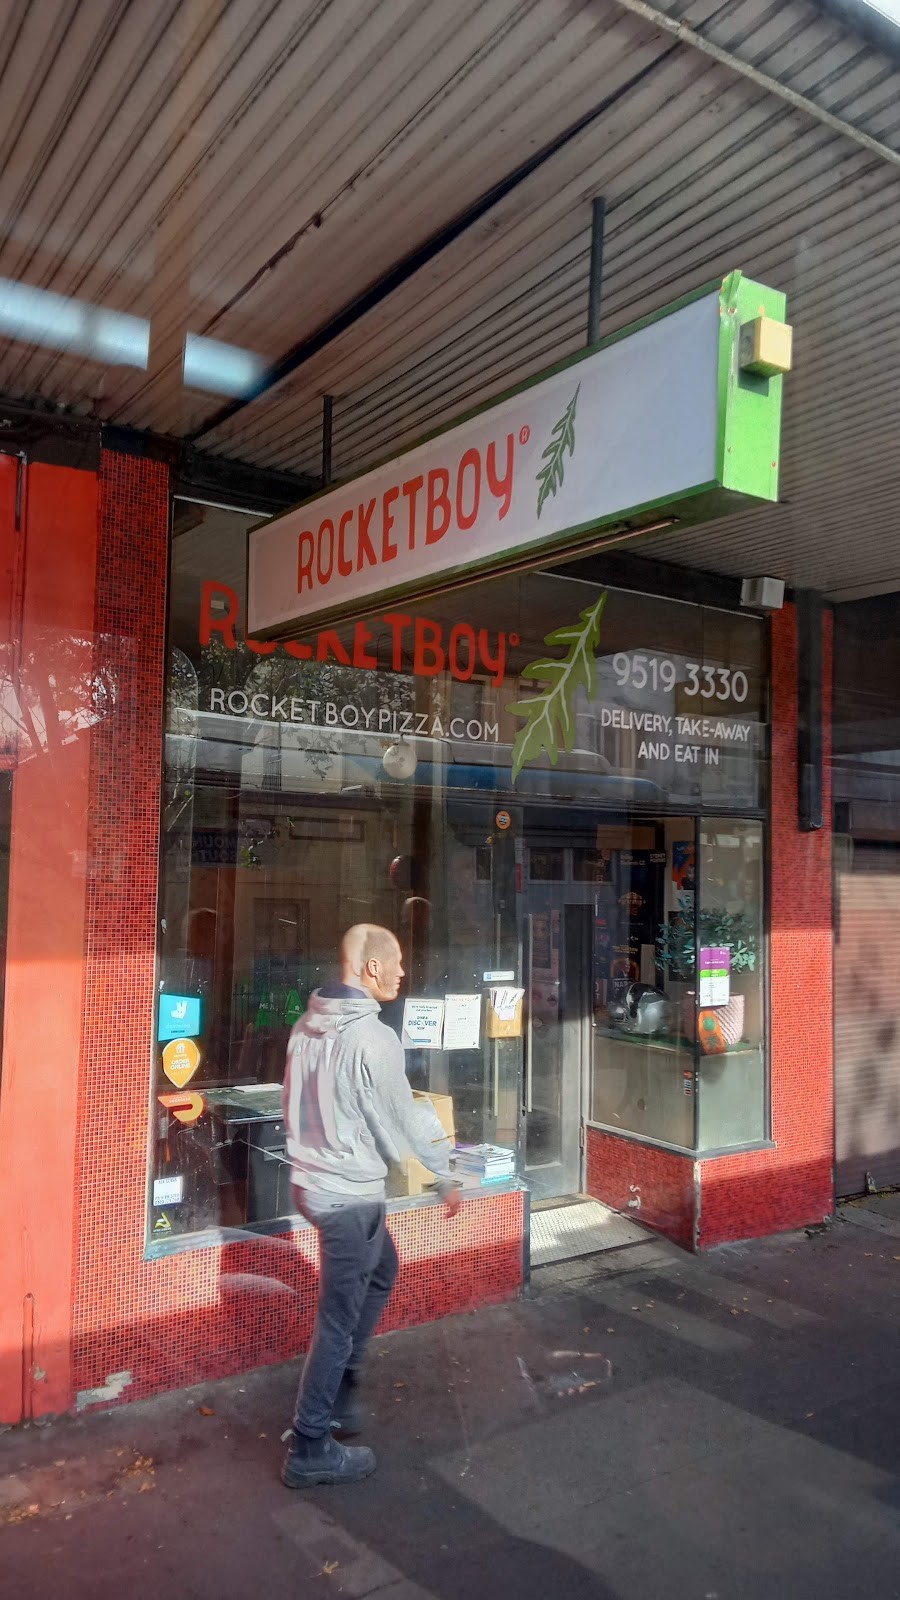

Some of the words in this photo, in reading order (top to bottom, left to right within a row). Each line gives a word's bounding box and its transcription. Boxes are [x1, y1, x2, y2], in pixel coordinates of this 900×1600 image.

[612, 652, 676, 693] 9519
[684, 663, 748, 703] 3330
[210, 687, 500, 742] ROCKETBOYPIZZA.COM
[601, 708, 672, 737] DELIVERY,
[675, 716, 750, 742] TAKE-AWAY
[637, 741, 670, 760] AND
[674, 745, 700, 764] EAT
[704, 749, 719, 765] IN
